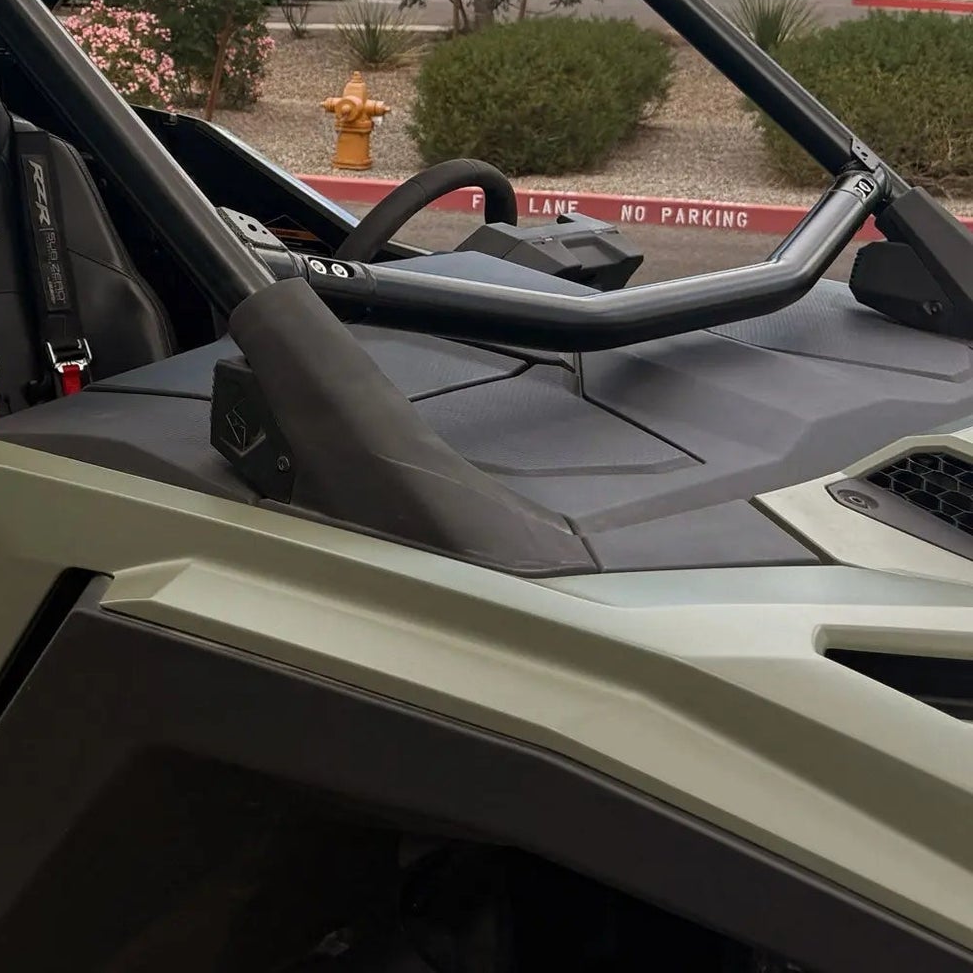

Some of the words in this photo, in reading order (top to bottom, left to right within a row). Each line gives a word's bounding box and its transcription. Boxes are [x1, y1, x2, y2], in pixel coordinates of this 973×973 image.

[28, 159, 51, 226] RZR
[528, 197, 579, 215] LANE
[620, 204, 646, 222] NO
[661, 207, 748, 228] PARKING
